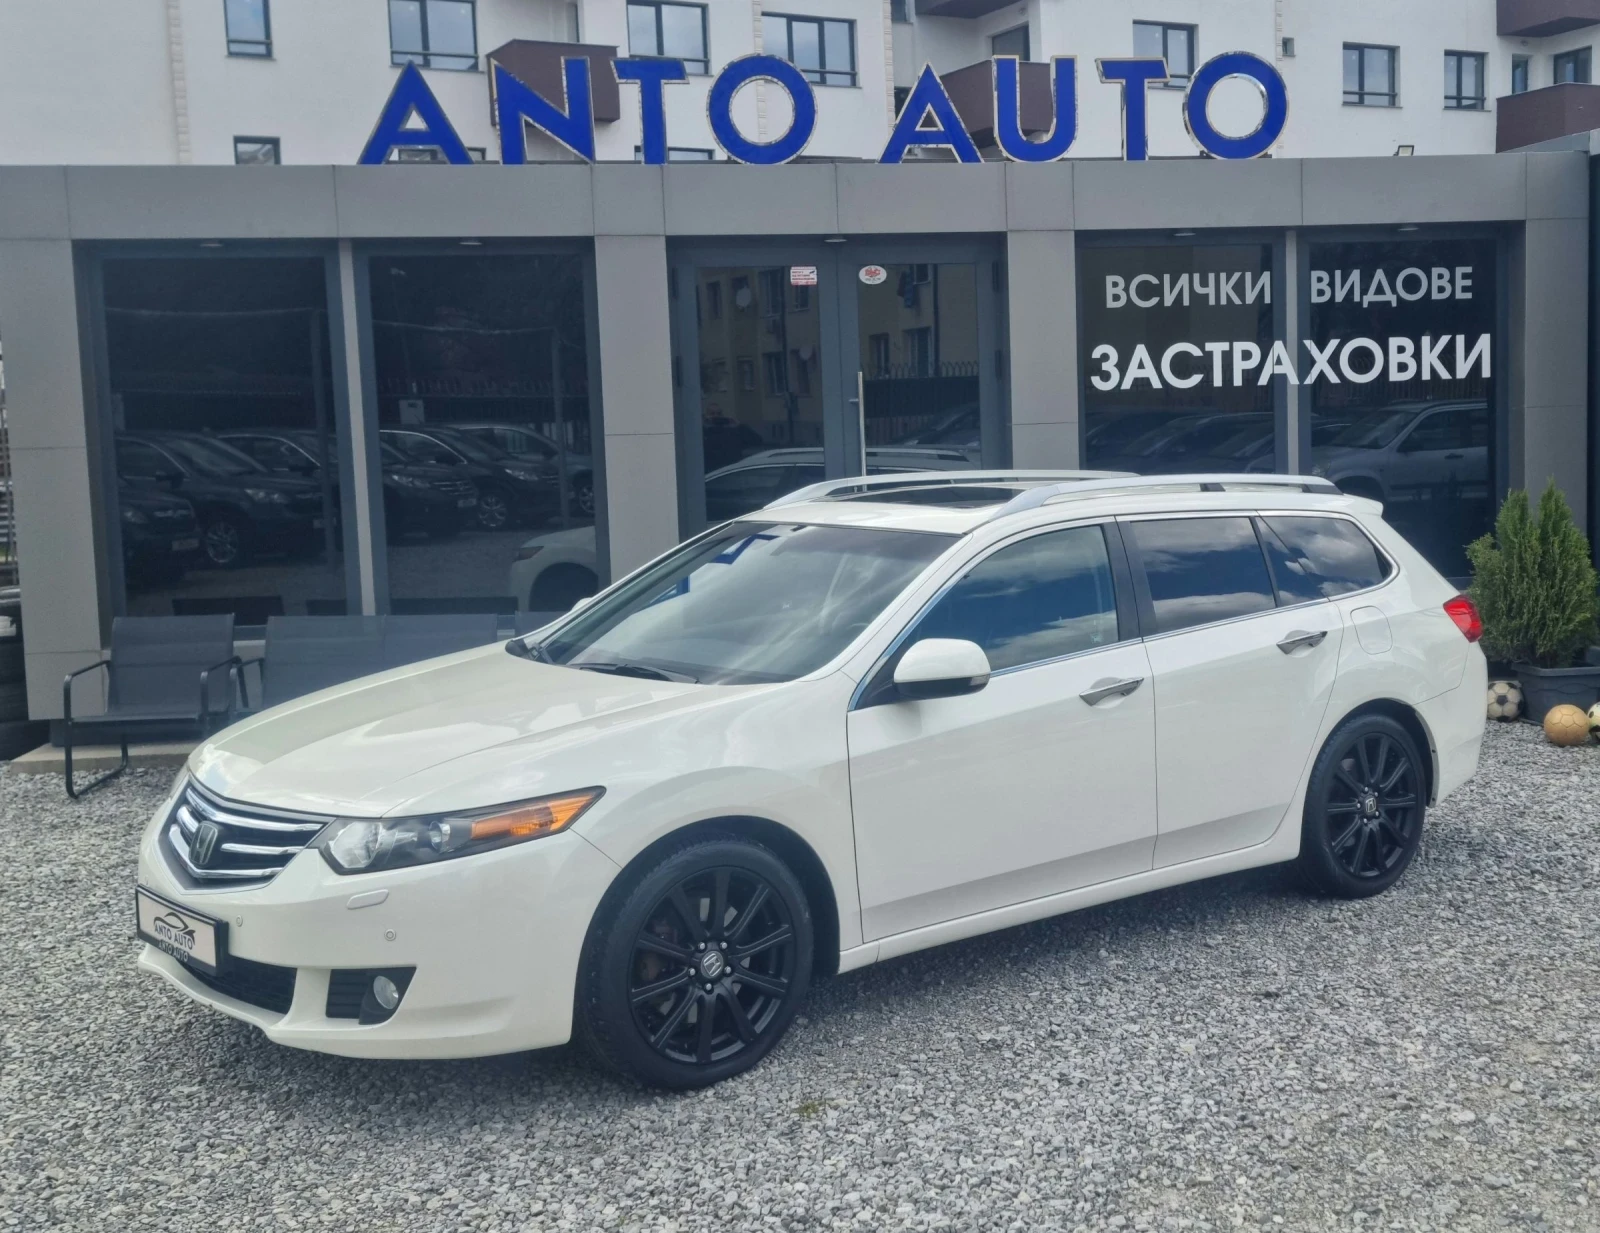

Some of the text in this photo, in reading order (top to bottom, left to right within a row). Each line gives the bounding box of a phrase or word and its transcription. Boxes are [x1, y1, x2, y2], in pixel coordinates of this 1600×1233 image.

[358, 51, 1290, 165] ANTO AUTO
[1105, 266, 1473, 308] ВСИЧКИ ВИДОВЕ
[1090, 333, 1491, 391] ЗАСТРАХОВКИ
[155, 924, 193, 950] ANTO AUTO
[159, 940, 189, 962] ANTO AUTO
